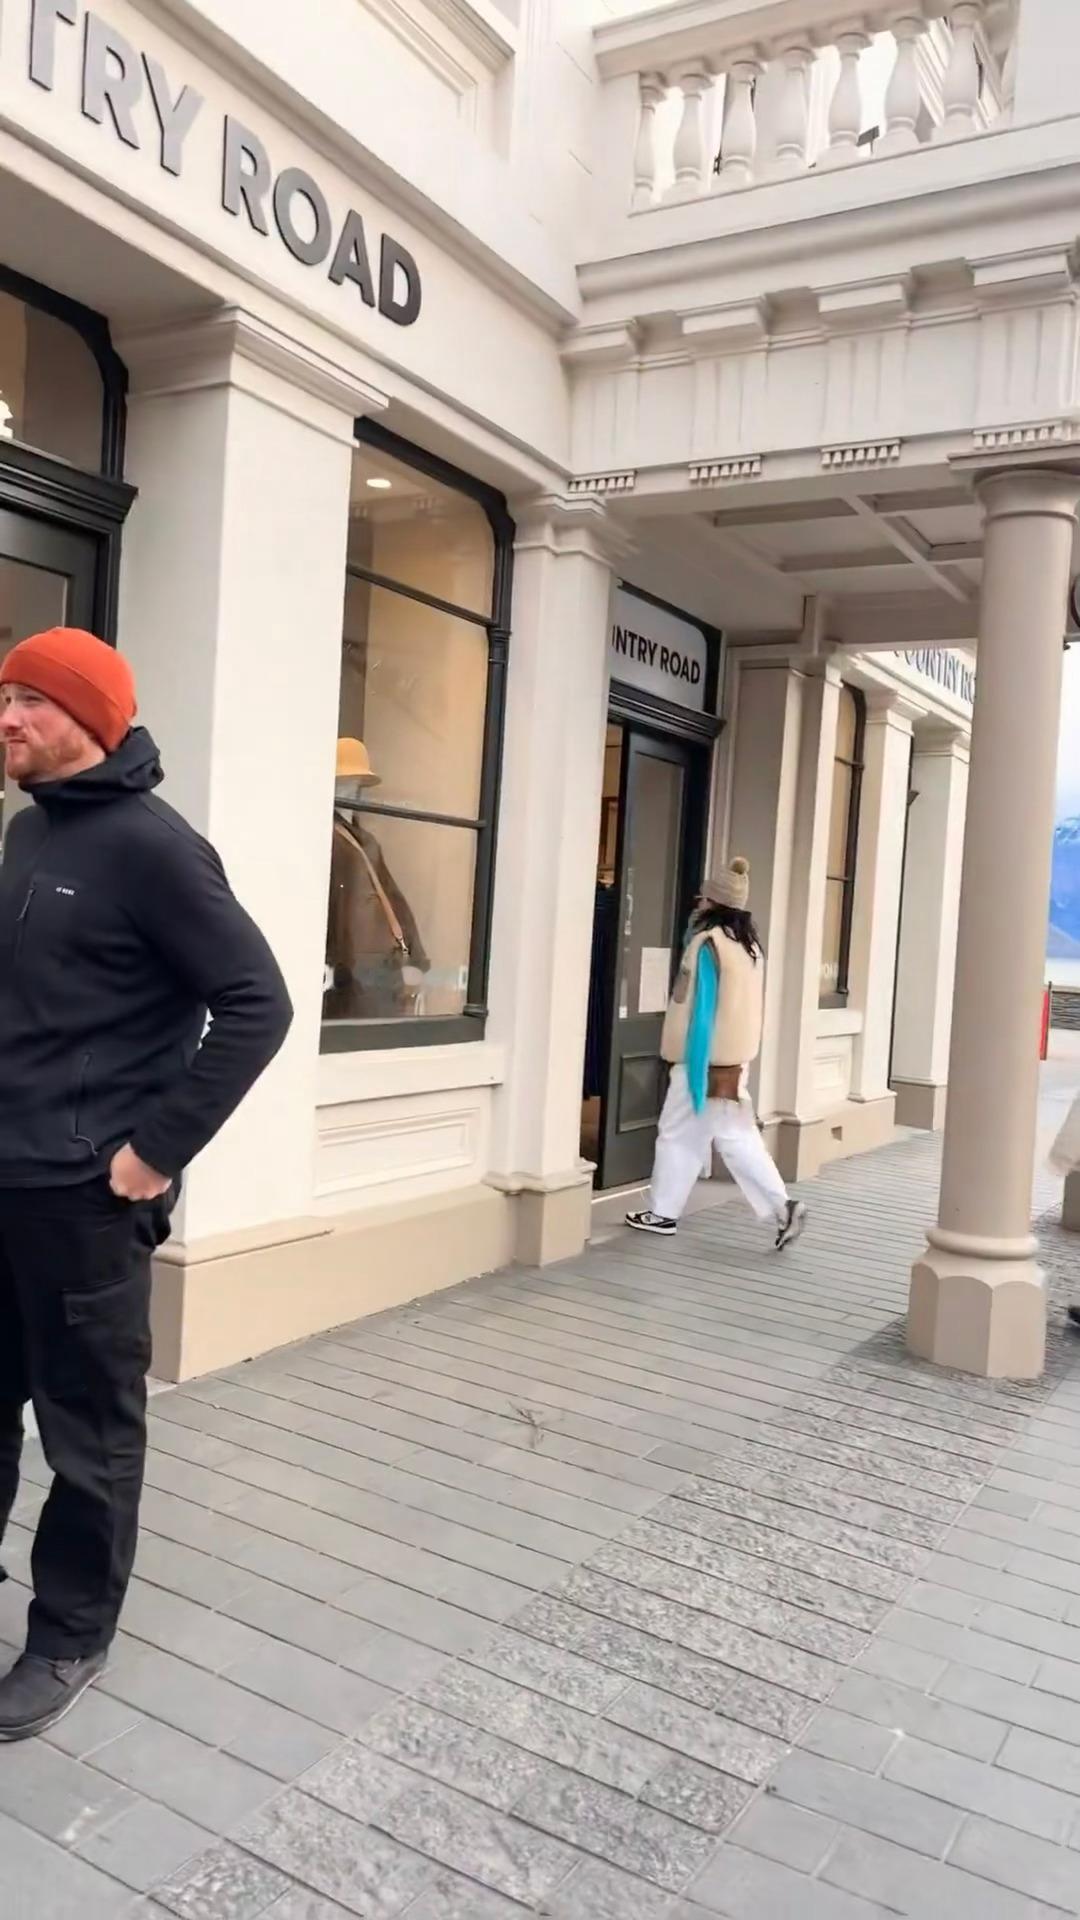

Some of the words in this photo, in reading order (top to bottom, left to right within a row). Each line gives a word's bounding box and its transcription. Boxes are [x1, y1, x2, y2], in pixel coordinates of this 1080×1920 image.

[222, 114, 422, 326] ROAD
[612, 625, 658, 667] NTRY
[660, 646, 701, 684] ROAD
